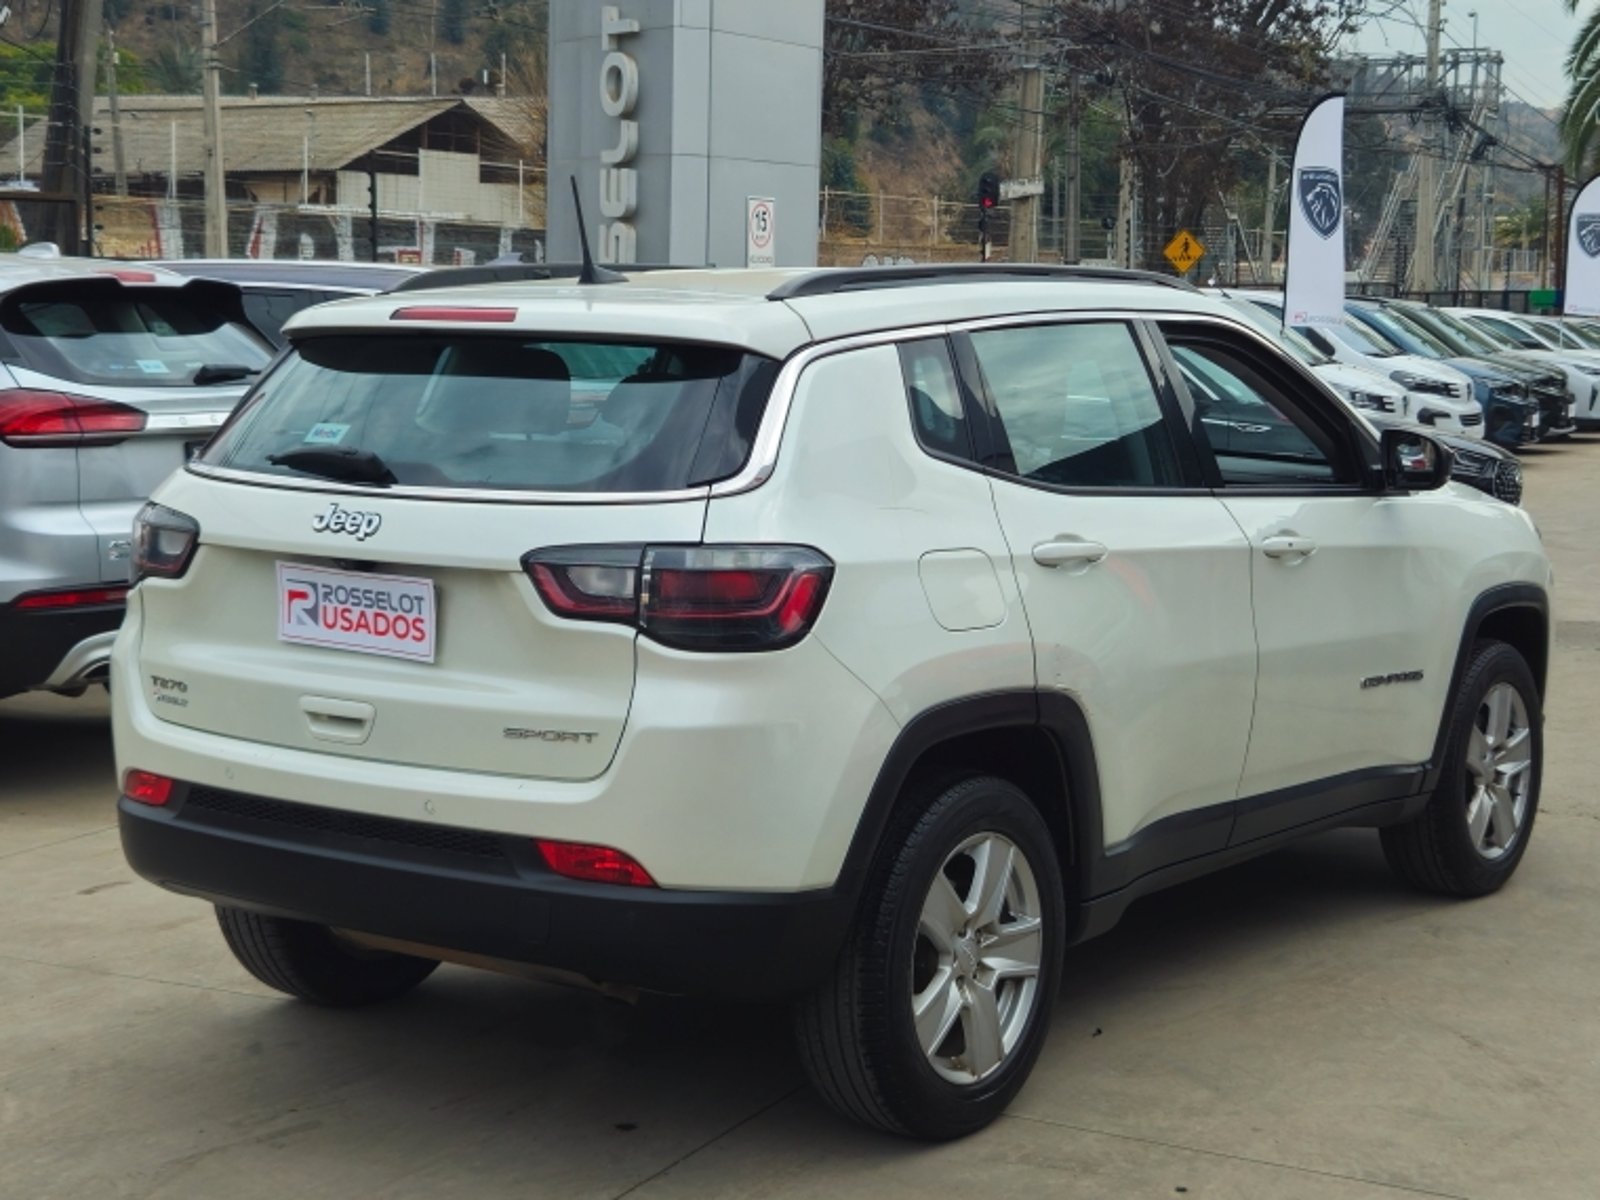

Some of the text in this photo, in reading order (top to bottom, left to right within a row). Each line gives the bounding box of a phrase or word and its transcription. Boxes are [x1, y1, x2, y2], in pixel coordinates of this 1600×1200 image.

[755, 209, 767, 233] 15
[312, 502, 381, 541] Jeep
[321, 583, 424, 616] ROSSELOT
[322, 605, 425, 642] USADOS
[503, 727, 599, 743] SPORT
